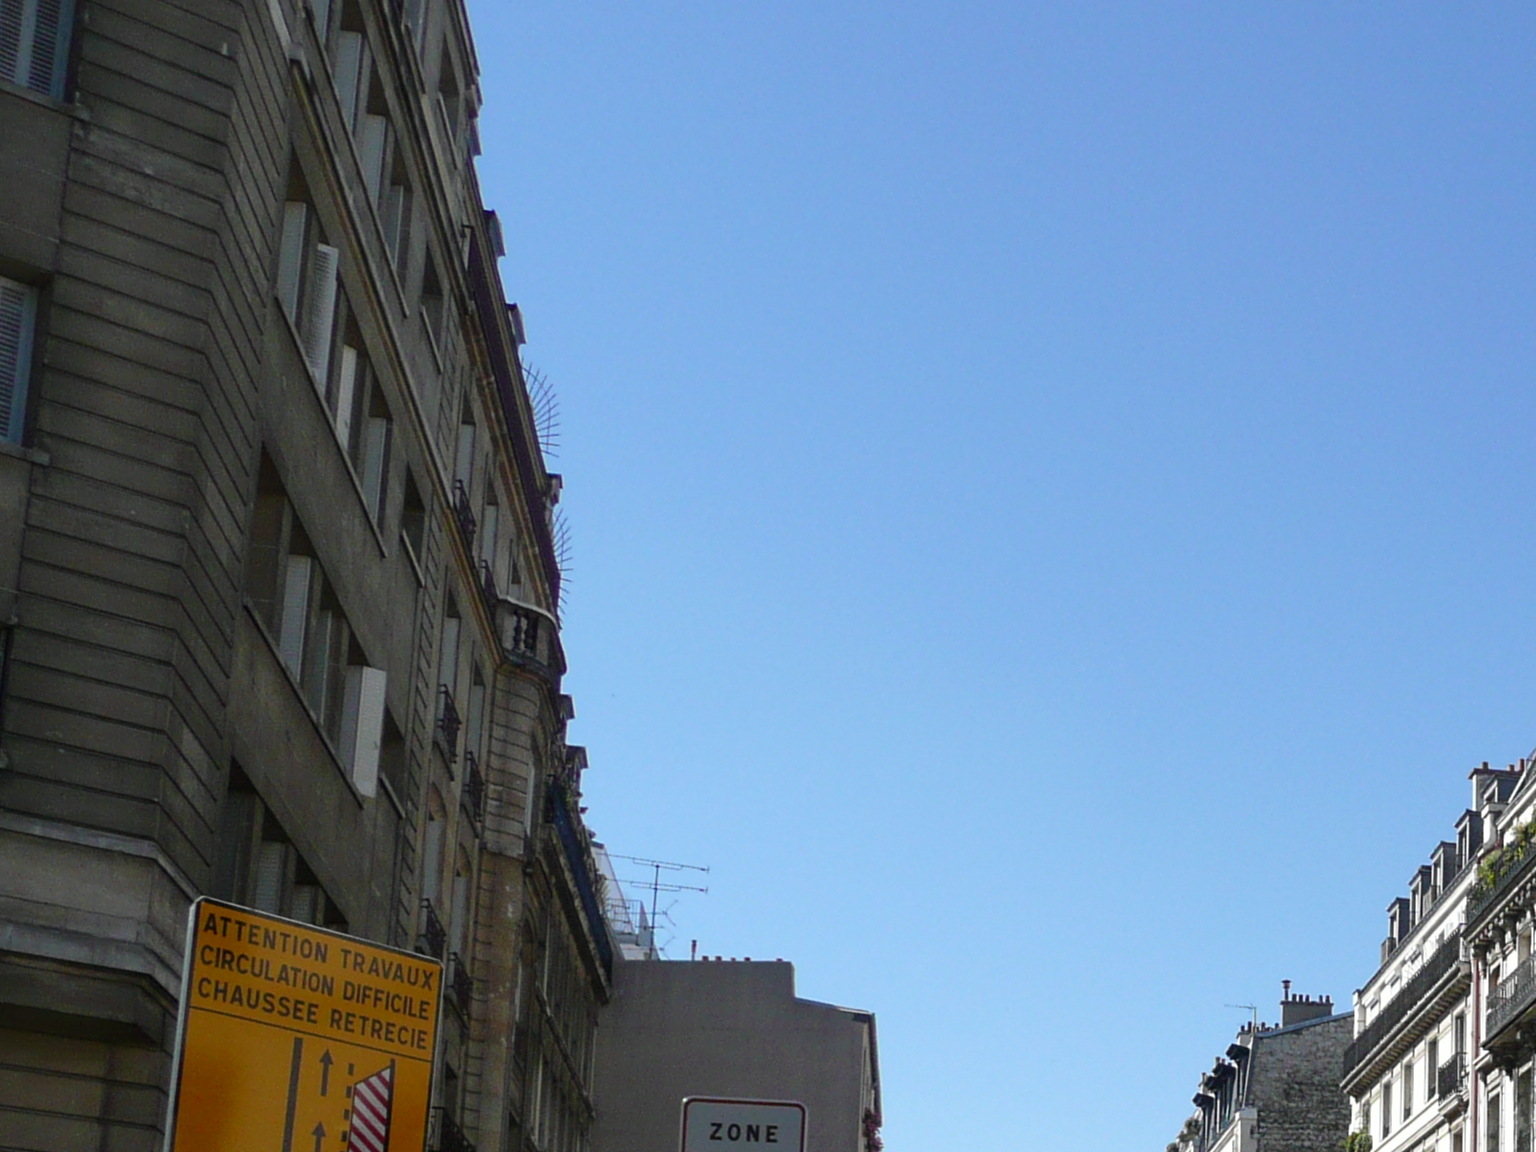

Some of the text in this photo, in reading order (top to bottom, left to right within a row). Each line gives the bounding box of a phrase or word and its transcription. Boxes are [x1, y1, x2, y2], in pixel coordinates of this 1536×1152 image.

[200, 945, 430, 1021] CIRCULATION DIFFICILE
[204, 912, 435, 991] ATTENTION TRAVAUX
[198, 977, 428, 1051] CHAUSSEE RETRECIE
[709, 1122, 778, 1143] ZONE
